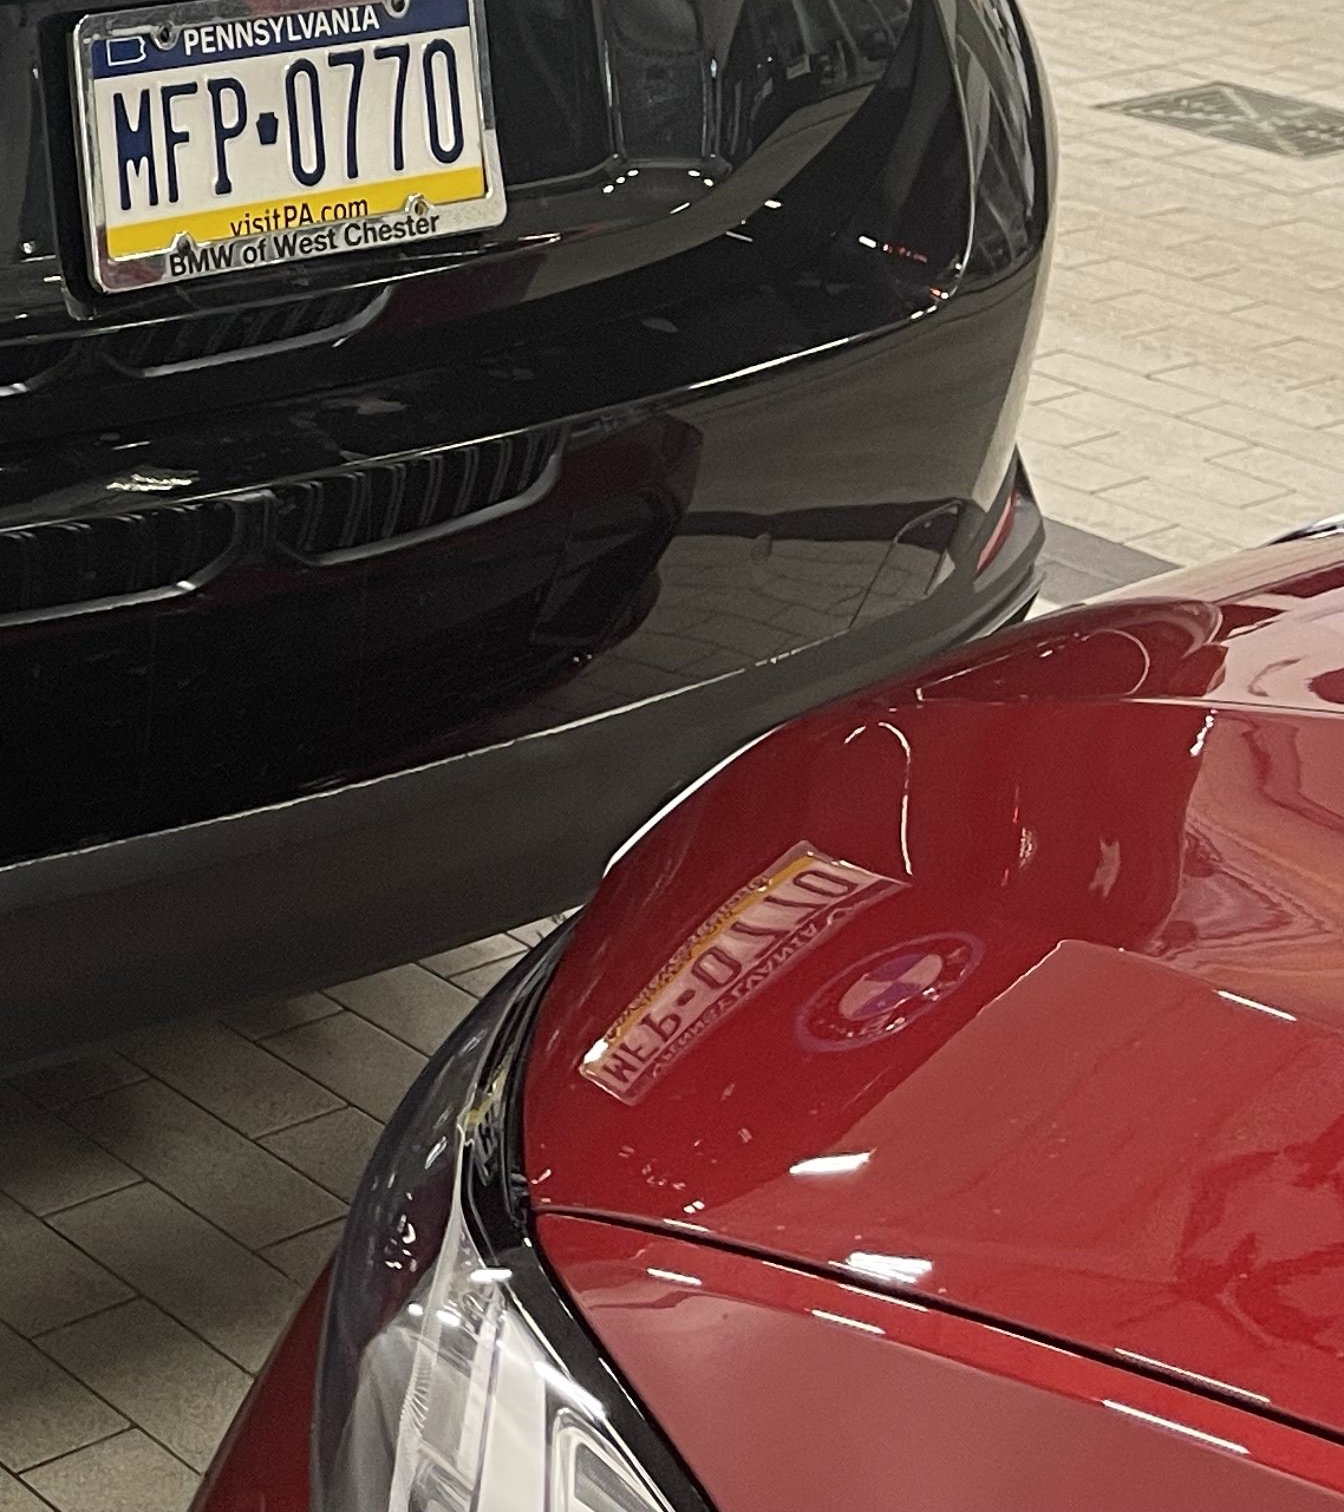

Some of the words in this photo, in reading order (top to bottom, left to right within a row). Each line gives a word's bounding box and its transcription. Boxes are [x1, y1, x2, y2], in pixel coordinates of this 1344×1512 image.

[184, 4, 380, 56] PENNSYLVANIA
[229, 198, 369, 237] visitPA.com
[169, 243, 235, 277] BMW
[242, 238, 267, 264] of
[273, 231, 336, 259] West
[344, 214, 440, 247] Chester
